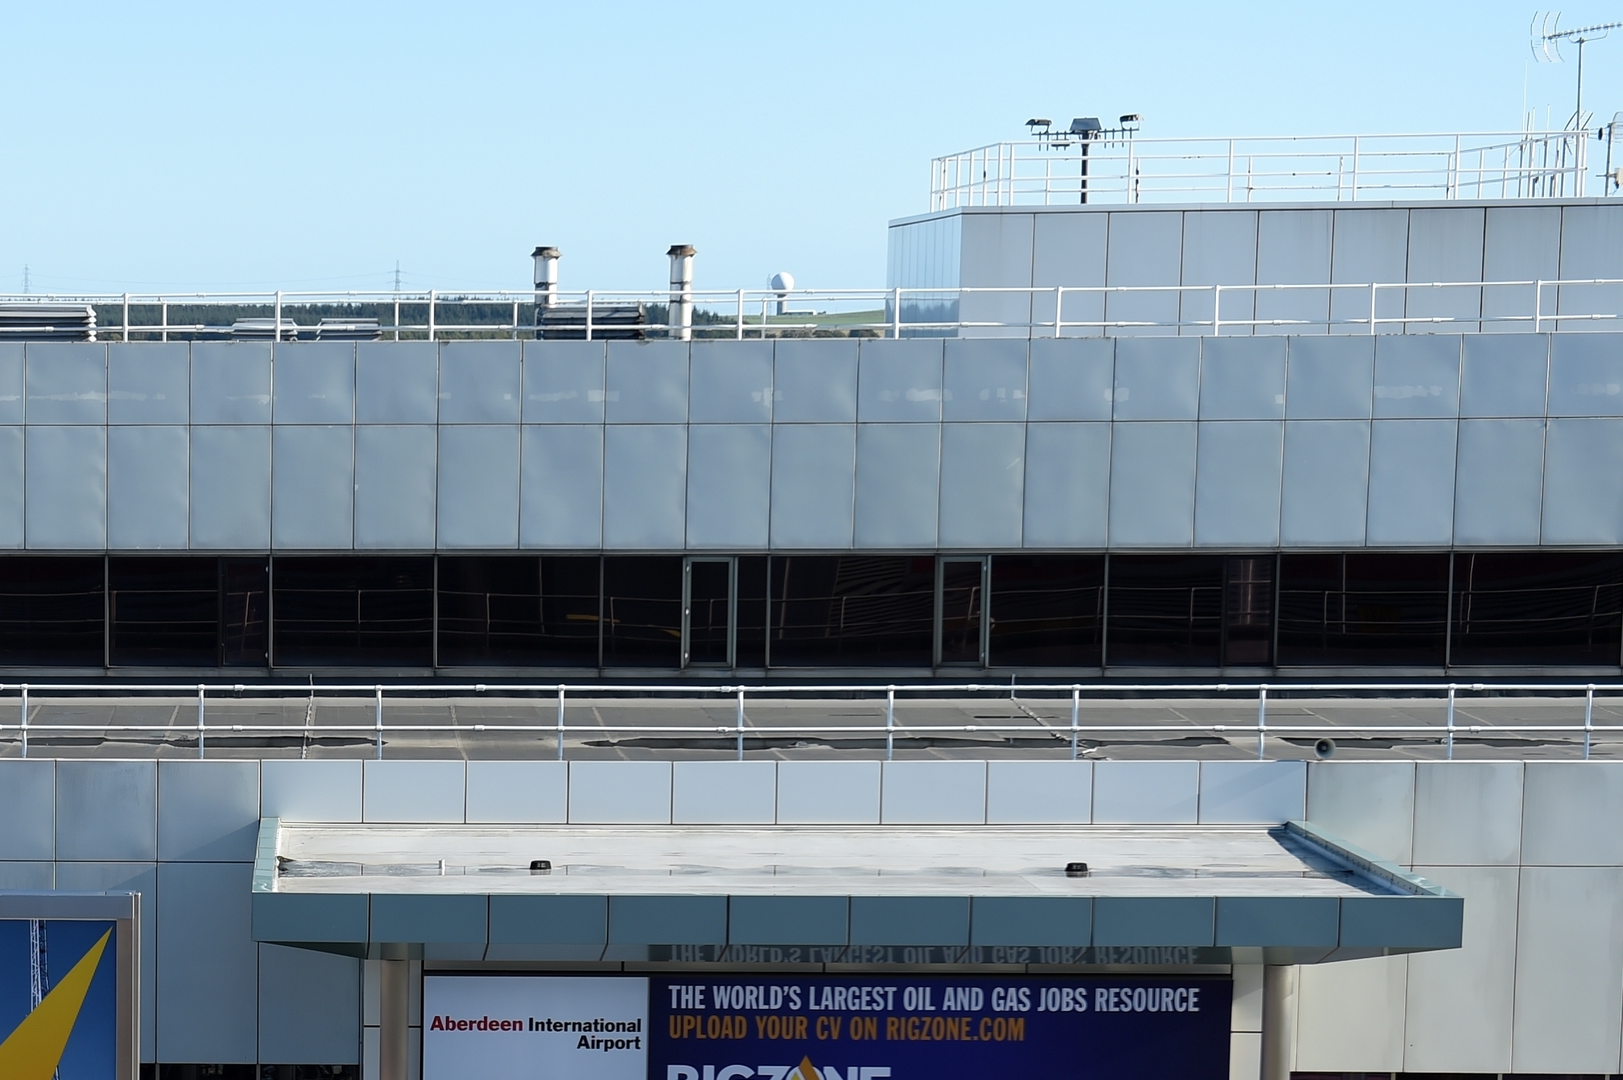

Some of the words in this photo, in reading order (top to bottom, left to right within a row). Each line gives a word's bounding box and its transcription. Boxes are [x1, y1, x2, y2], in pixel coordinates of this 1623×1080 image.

[668, 985, 705, 1009] THE
[809, 986, 897, 1011] LARGEST
[903, 986, 936, 1011] OIL
[942, 987, 984, 1011] AND
[991, 987, 1031, 1011] GAS
[1037, 987, 1087, 1012] JOBS
[1094, 988, 1200, 1012] RESOURCE
[430, 1016, 523, 1031] Aberdeen
[528, 1017, 641, 1033] International
[669, 1015, 747, 1039] UPLOAD
[755, 1015, 808, 1040] YOUR
[816, 1016, 842, 1040] CV
[849, 1016, 877, 1040] ON
[886, 1016, 1025, 1041] RIGZONE.COM
[577, 1035, 641, 1052] Airport
